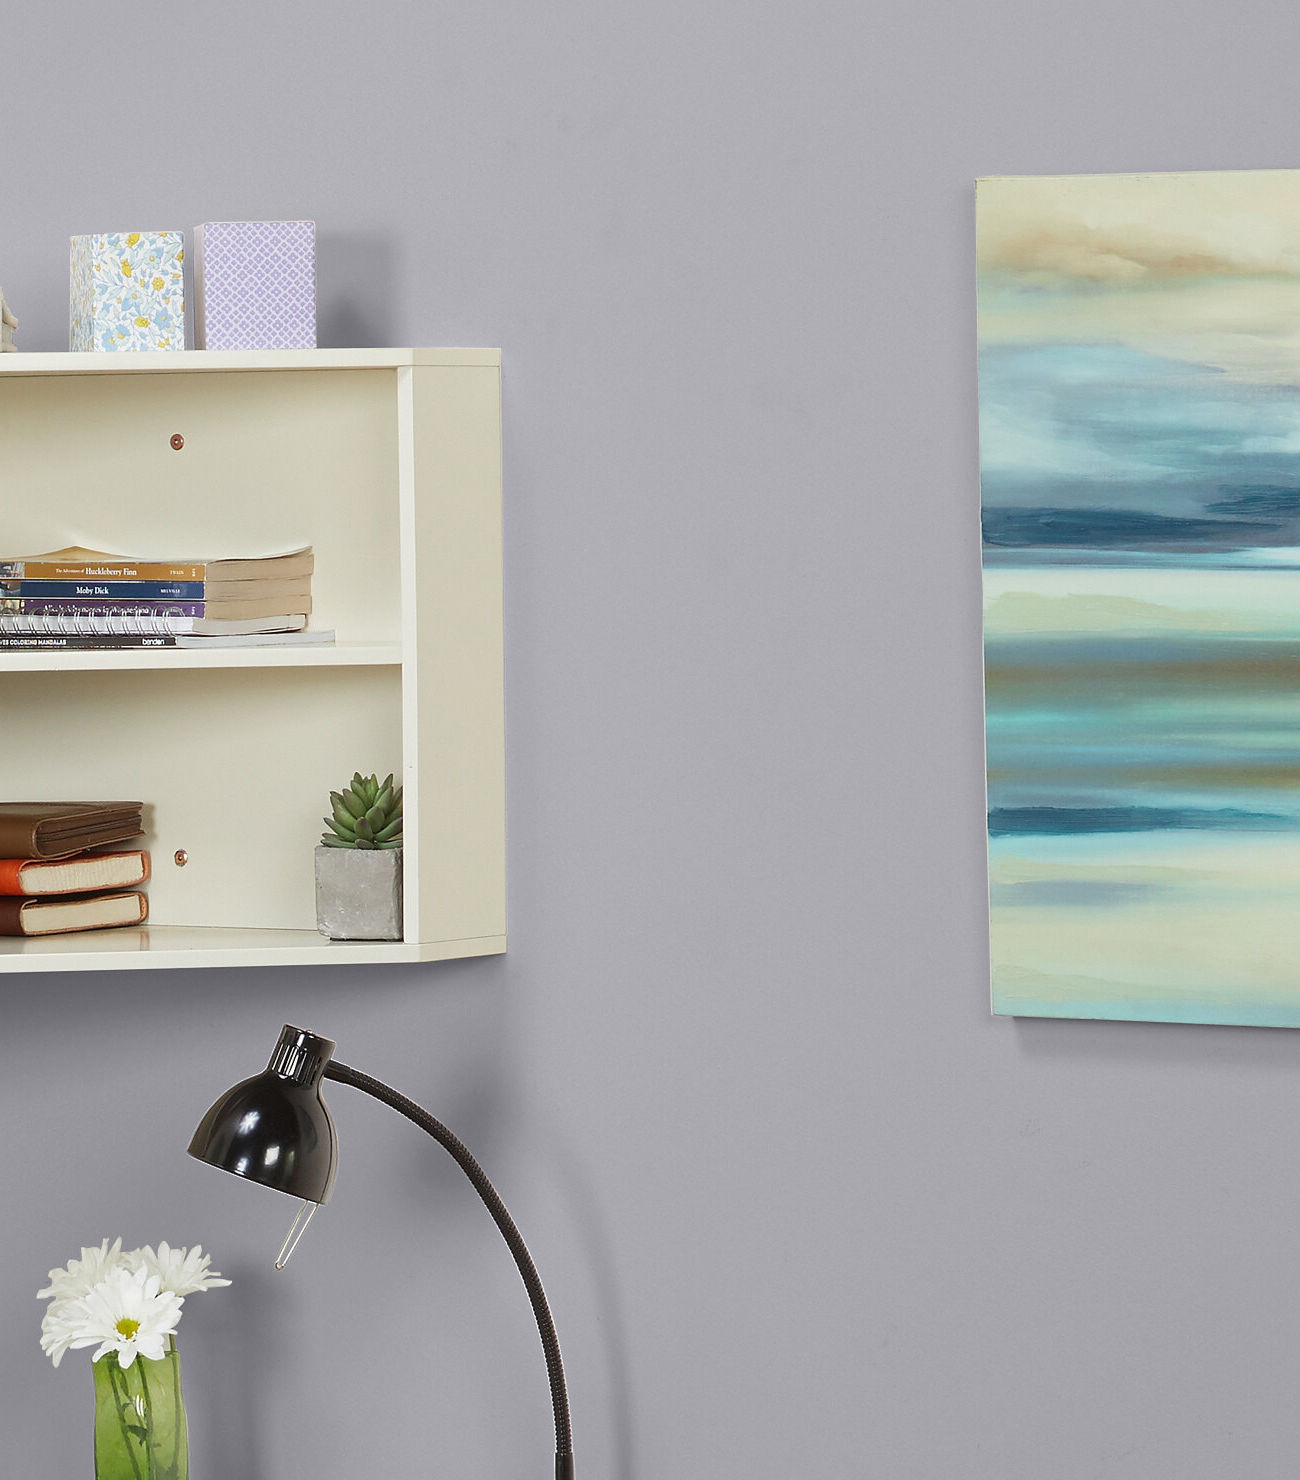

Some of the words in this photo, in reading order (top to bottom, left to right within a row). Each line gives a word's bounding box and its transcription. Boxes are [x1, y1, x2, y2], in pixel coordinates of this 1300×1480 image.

[85, 567, 122, 576] Huckleberry
[123, 567, 137, 575] Finn
[76, 587, 94, 595] Moby
[94, 586, 109, 594] Dick
